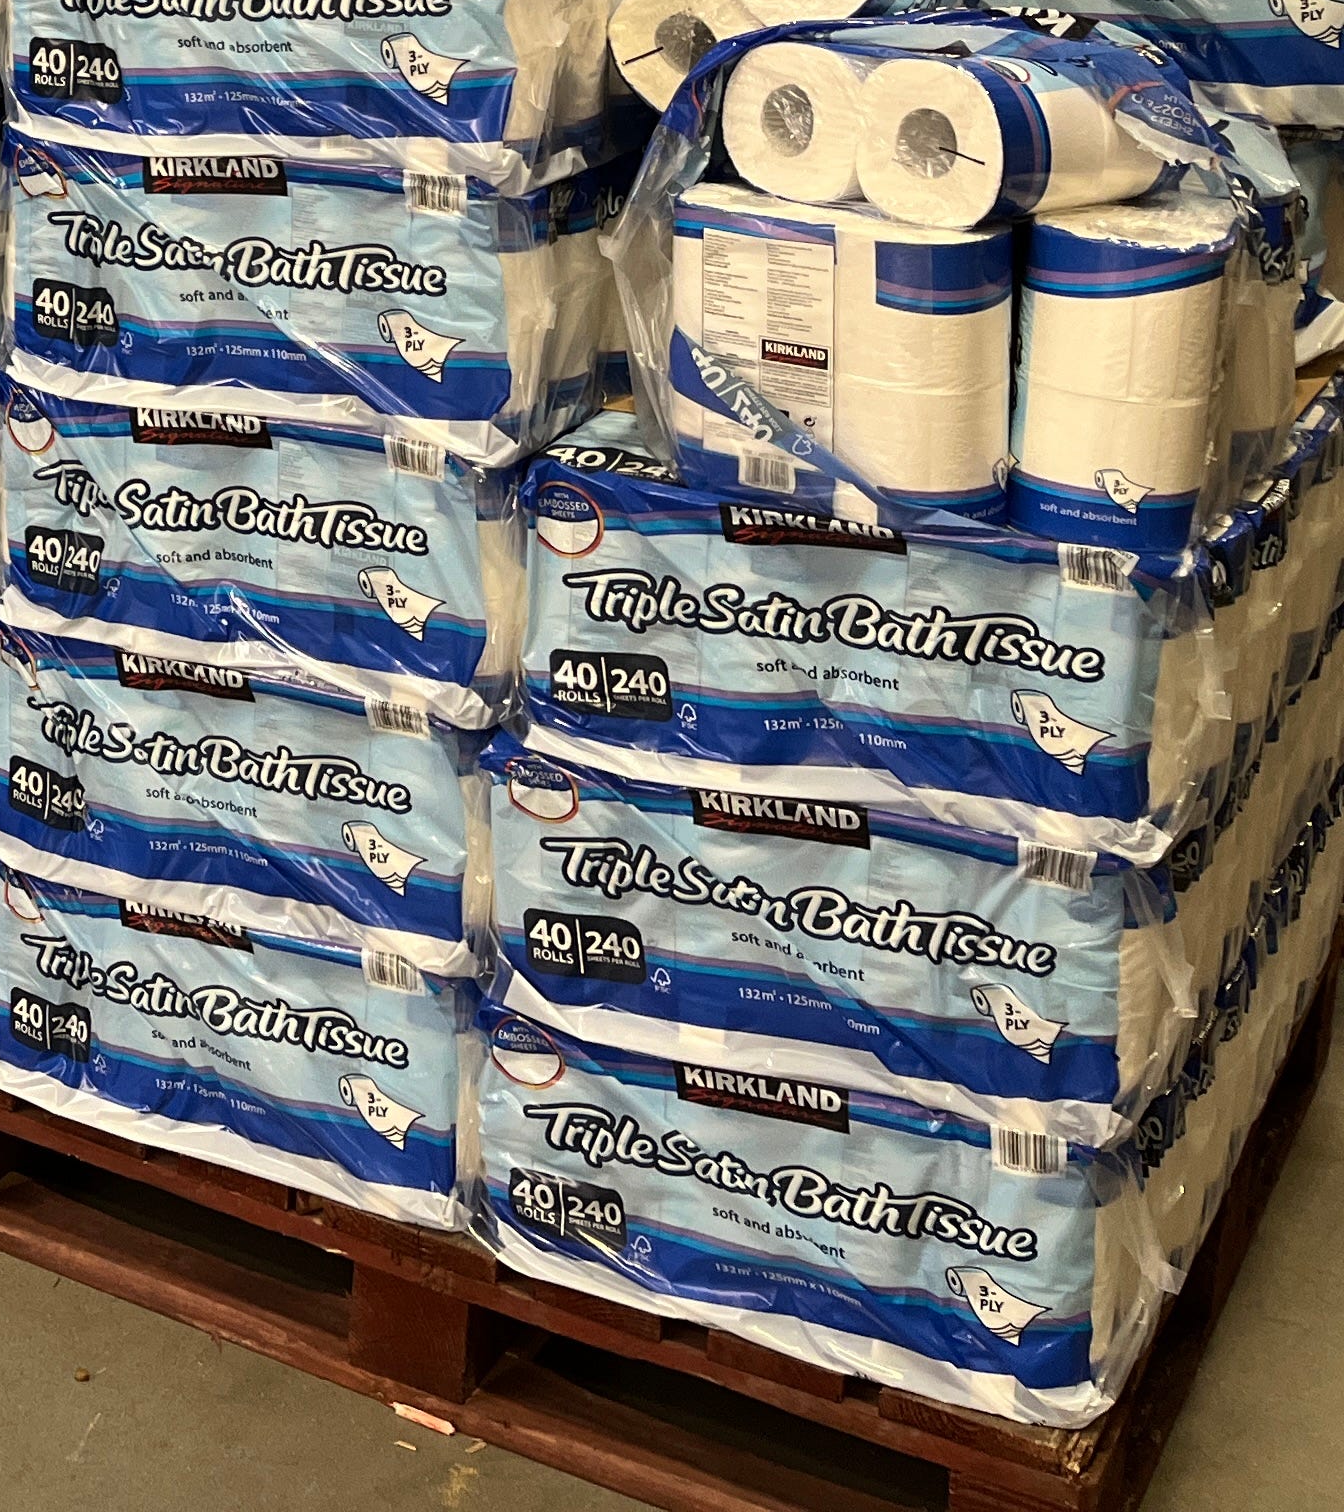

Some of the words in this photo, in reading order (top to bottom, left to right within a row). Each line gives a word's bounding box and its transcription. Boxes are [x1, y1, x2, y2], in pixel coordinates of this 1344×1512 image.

[765, 342, 826, 361] KIRKLAND
[1113, 486, 1128, 494] PLY
[115, 479, 217, 530] Satin
[217, 487, 316, 541] Bath
[310, 500, 428, 555] Tissue
[538, 499, 589, 513] EMBOSSED
[1039, 502, 1057, 513] soft
[1060, 507, 1080, 516] and
[1083, 509, 1137, 526] absorbent
[729, 507, 895, 540] KIRKLAND
[185, 550, 210, 562] and
[215, 549, 273, 570] absorbent
[563, 570, 698, 633] Triple
[700, 586, 827, 641] Satin
[828, 595, 958, 659] Bath
[950, 614, 1105, 681] Tissue
[557, 661, 597, 688] 40
[611, 668, 665, 698] 240
[822, 666, 899, 691] absorbent
[558, 690, 601, 704] ROLLS
[858, 733, 907, 750] 110mm
[1040, 726, 1065, 739] PLY
[684, 1066, 842, 1112] KIRKLAND
[523, 1103, 655, 1165] Triple
[773, 1167, 904, 1235] Bath
[895, 1193, 1038, 1261] Tissue
[512, 1180, 555, 1209] 40
[568, 1198, 622, 1225] 240
[980, 1299, 1003, 1312] PLY
